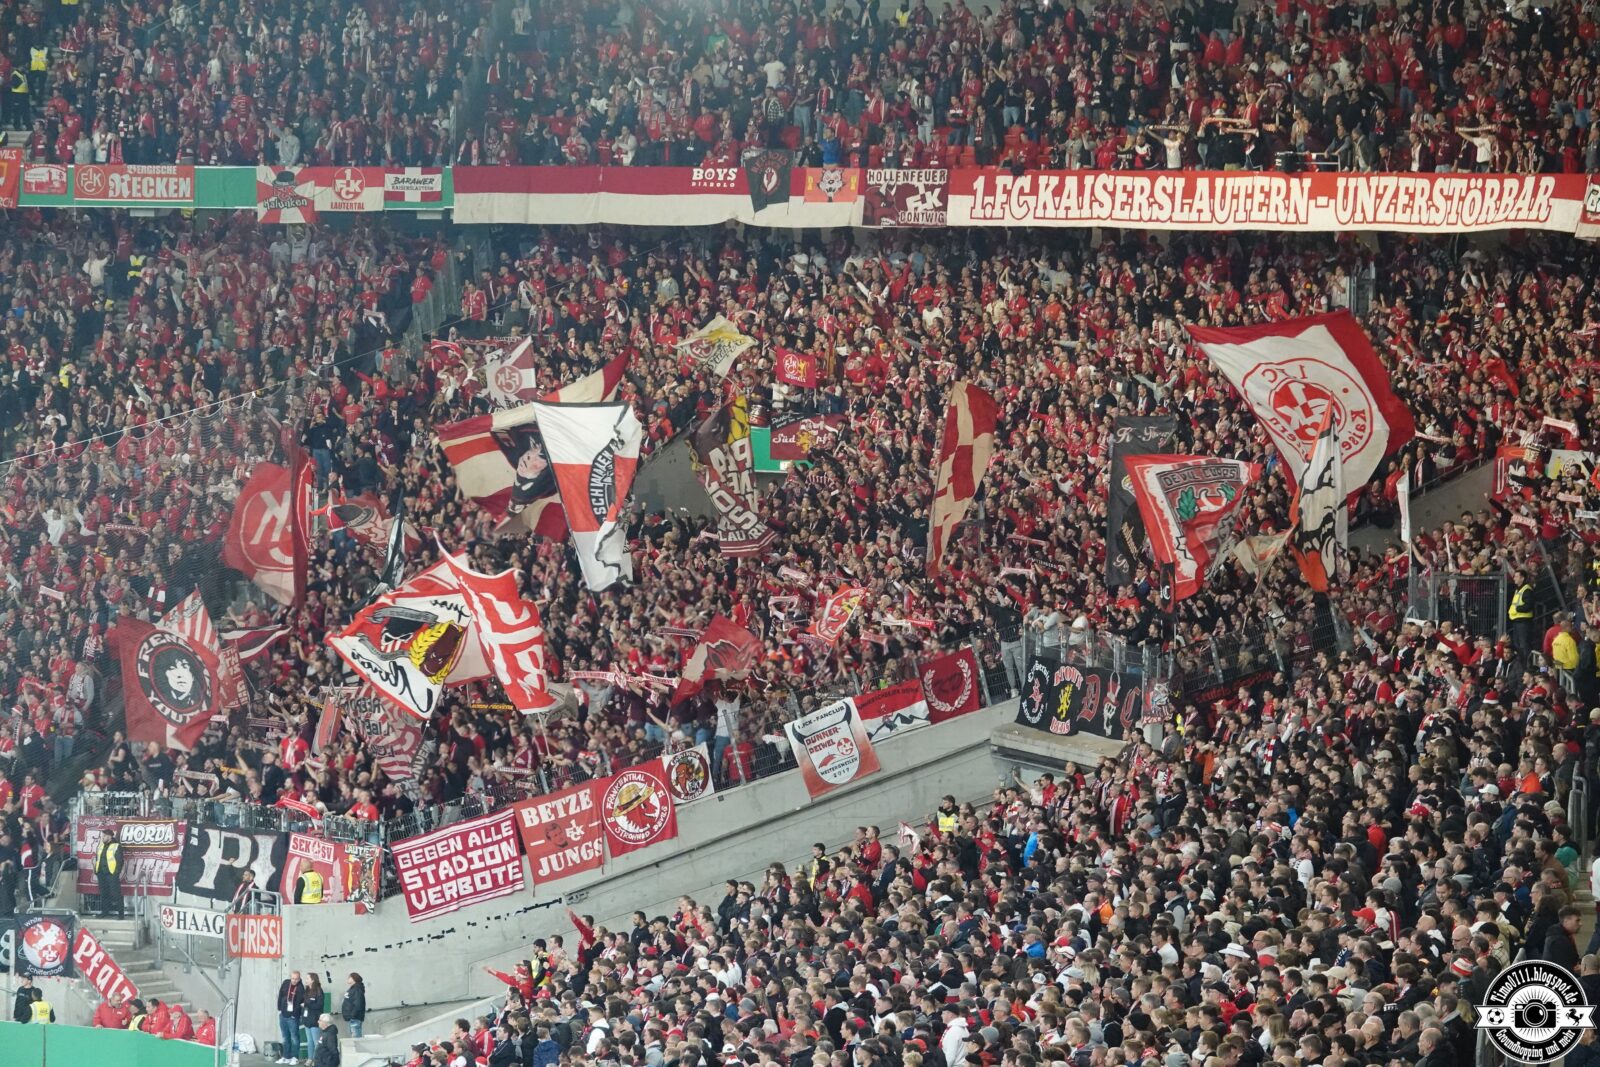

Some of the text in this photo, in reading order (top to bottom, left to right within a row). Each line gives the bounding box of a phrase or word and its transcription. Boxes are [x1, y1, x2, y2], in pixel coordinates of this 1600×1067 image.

[108, 173, 191, 198] RECKEN
[692, 168, 738, 181] BOYS
[1033, 172, 1312, 225] KAISERSLAUTERN
[1335, 176, 1557, 226] UNZERSTÖRBAR
[900, 211, 948, 224] CONTWIG
[519, 788, 594, 830] BETZE
[121, 823, 174, 842] HORDA
[292, 836, 333, 860] SEK SV
[397, 819, 514, 869] GEGEN ALLE
[402, 841, 518, 889] STADION
[537, 837, 604, 878] JUNGS
[410, 861, 523, 911] VERBOTE
[176, 911, 224, 934] HAAG
